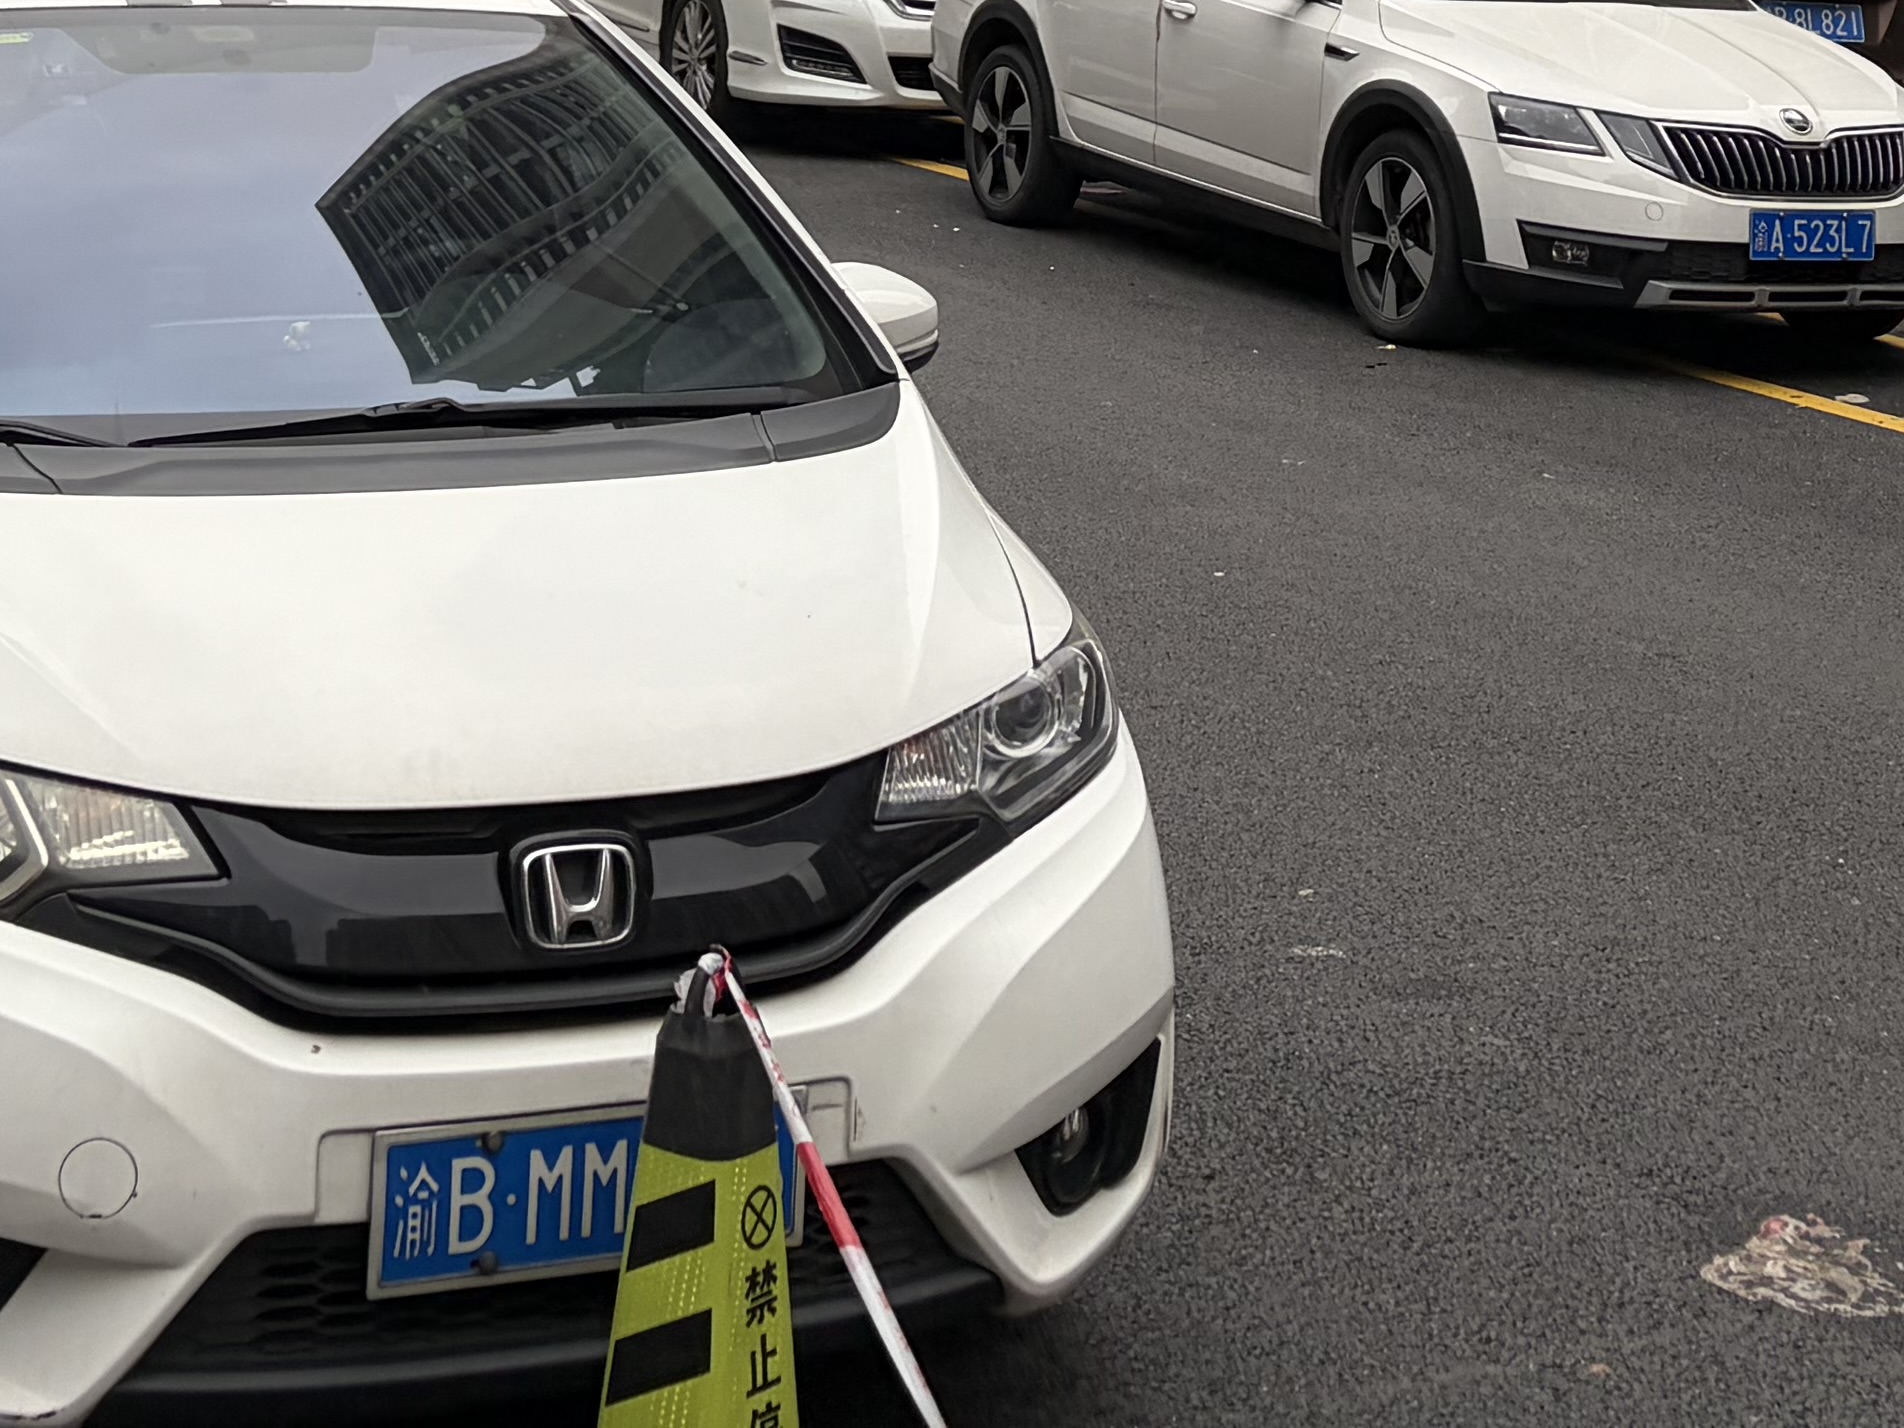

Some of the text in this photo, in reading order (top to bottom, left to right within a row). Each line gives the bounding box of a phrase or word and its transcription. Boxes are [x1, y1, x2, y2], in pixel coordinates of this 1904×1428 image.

[1767, 6, 1858, 37] ·8L821
[1754, 218, 1871, 253] 渝A·523L7
[393, 1138, 629, 1260] 渝B·MM
